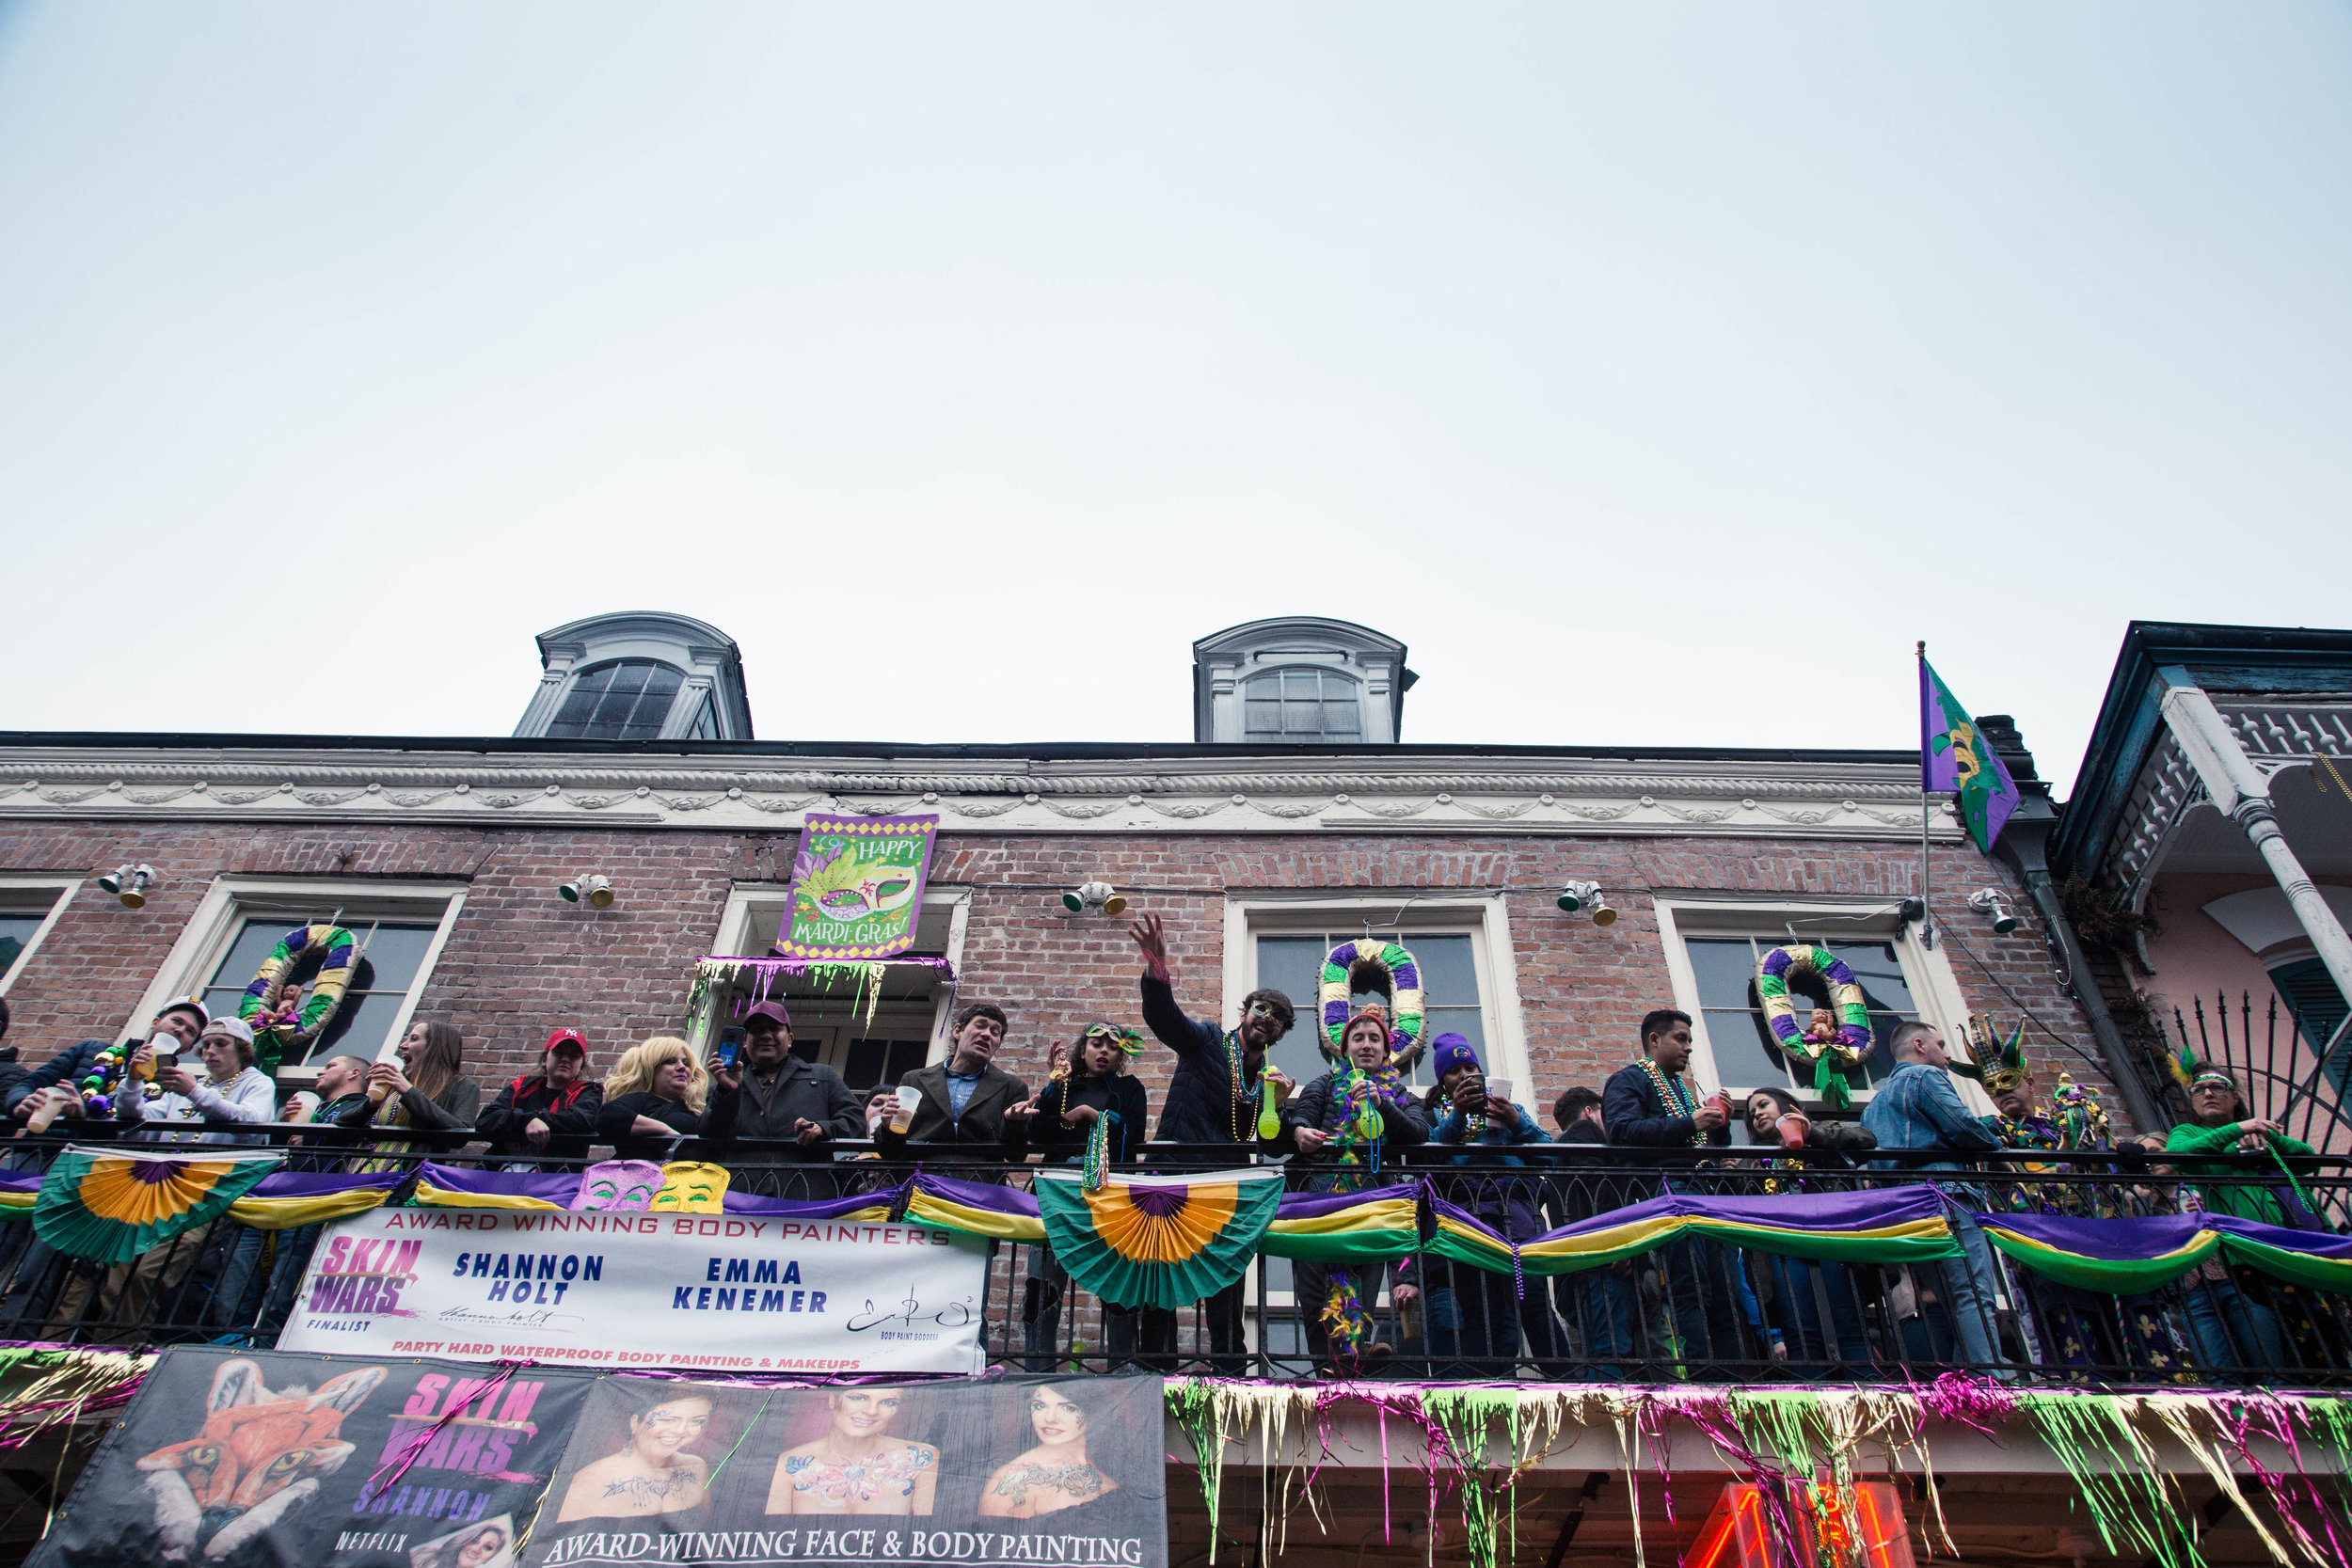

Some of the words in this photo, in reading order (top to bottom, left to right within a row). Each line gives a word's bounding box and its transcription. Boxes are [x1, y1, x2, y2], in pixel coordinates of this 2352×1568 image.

[859, 840, 922, 860] HAPPY
[794, 922, 851, 944] MARDI
[855, 917, 908, 945] GRAS!
[385, 1212, 499, 1231] AWARD
[513, 1214, 659, 1234] WINNING
[674, 1218, 770, 1239] BODY
[782, 1223, 950, 1246] PAINTERS
[322, 1236, 422, 1274] SKIN
[453, 1252, 604, 1281] SHANNON
[707, 1257, 802, 1285] EMMA
[307, 1275, 407, 1314] WARS
[486, 1280, 569, 1306] HOLT
[672, 1286, 828, 1313] KENEMER
[306, 1319, 371, 1332] FINALIST
[881, 1331, 896, 1339] BODY
[897, 1332, 913, 1340] PAINT
[391, 1340, 444, 1353] PARTY
[447, 1341, 495, 1355] HARD
[501, 1344, 614, 1362] WATERPROOF
[617, 1351, 666, 1364] BODY
[669, 1354, 754, 1368] PAINTING
[759, 1357, 771, 1368] &
[777, 1358, 861, 1370] MAKEUPS
[403, 1373, 545, 1422] SKIN
[352, 1481, 491, 1522] SHANNON
[334, 1531, 408, 1553] NETFLIX
[543, 1528, 798, 1563] AWARD-WINNING
[803, 1528, 876, 1559] FACE
[882, 1529, 901, 1558] &
[909, 1530, 993, 1560] BODY
[999, 1533, 1143, 1564] PAINTING
